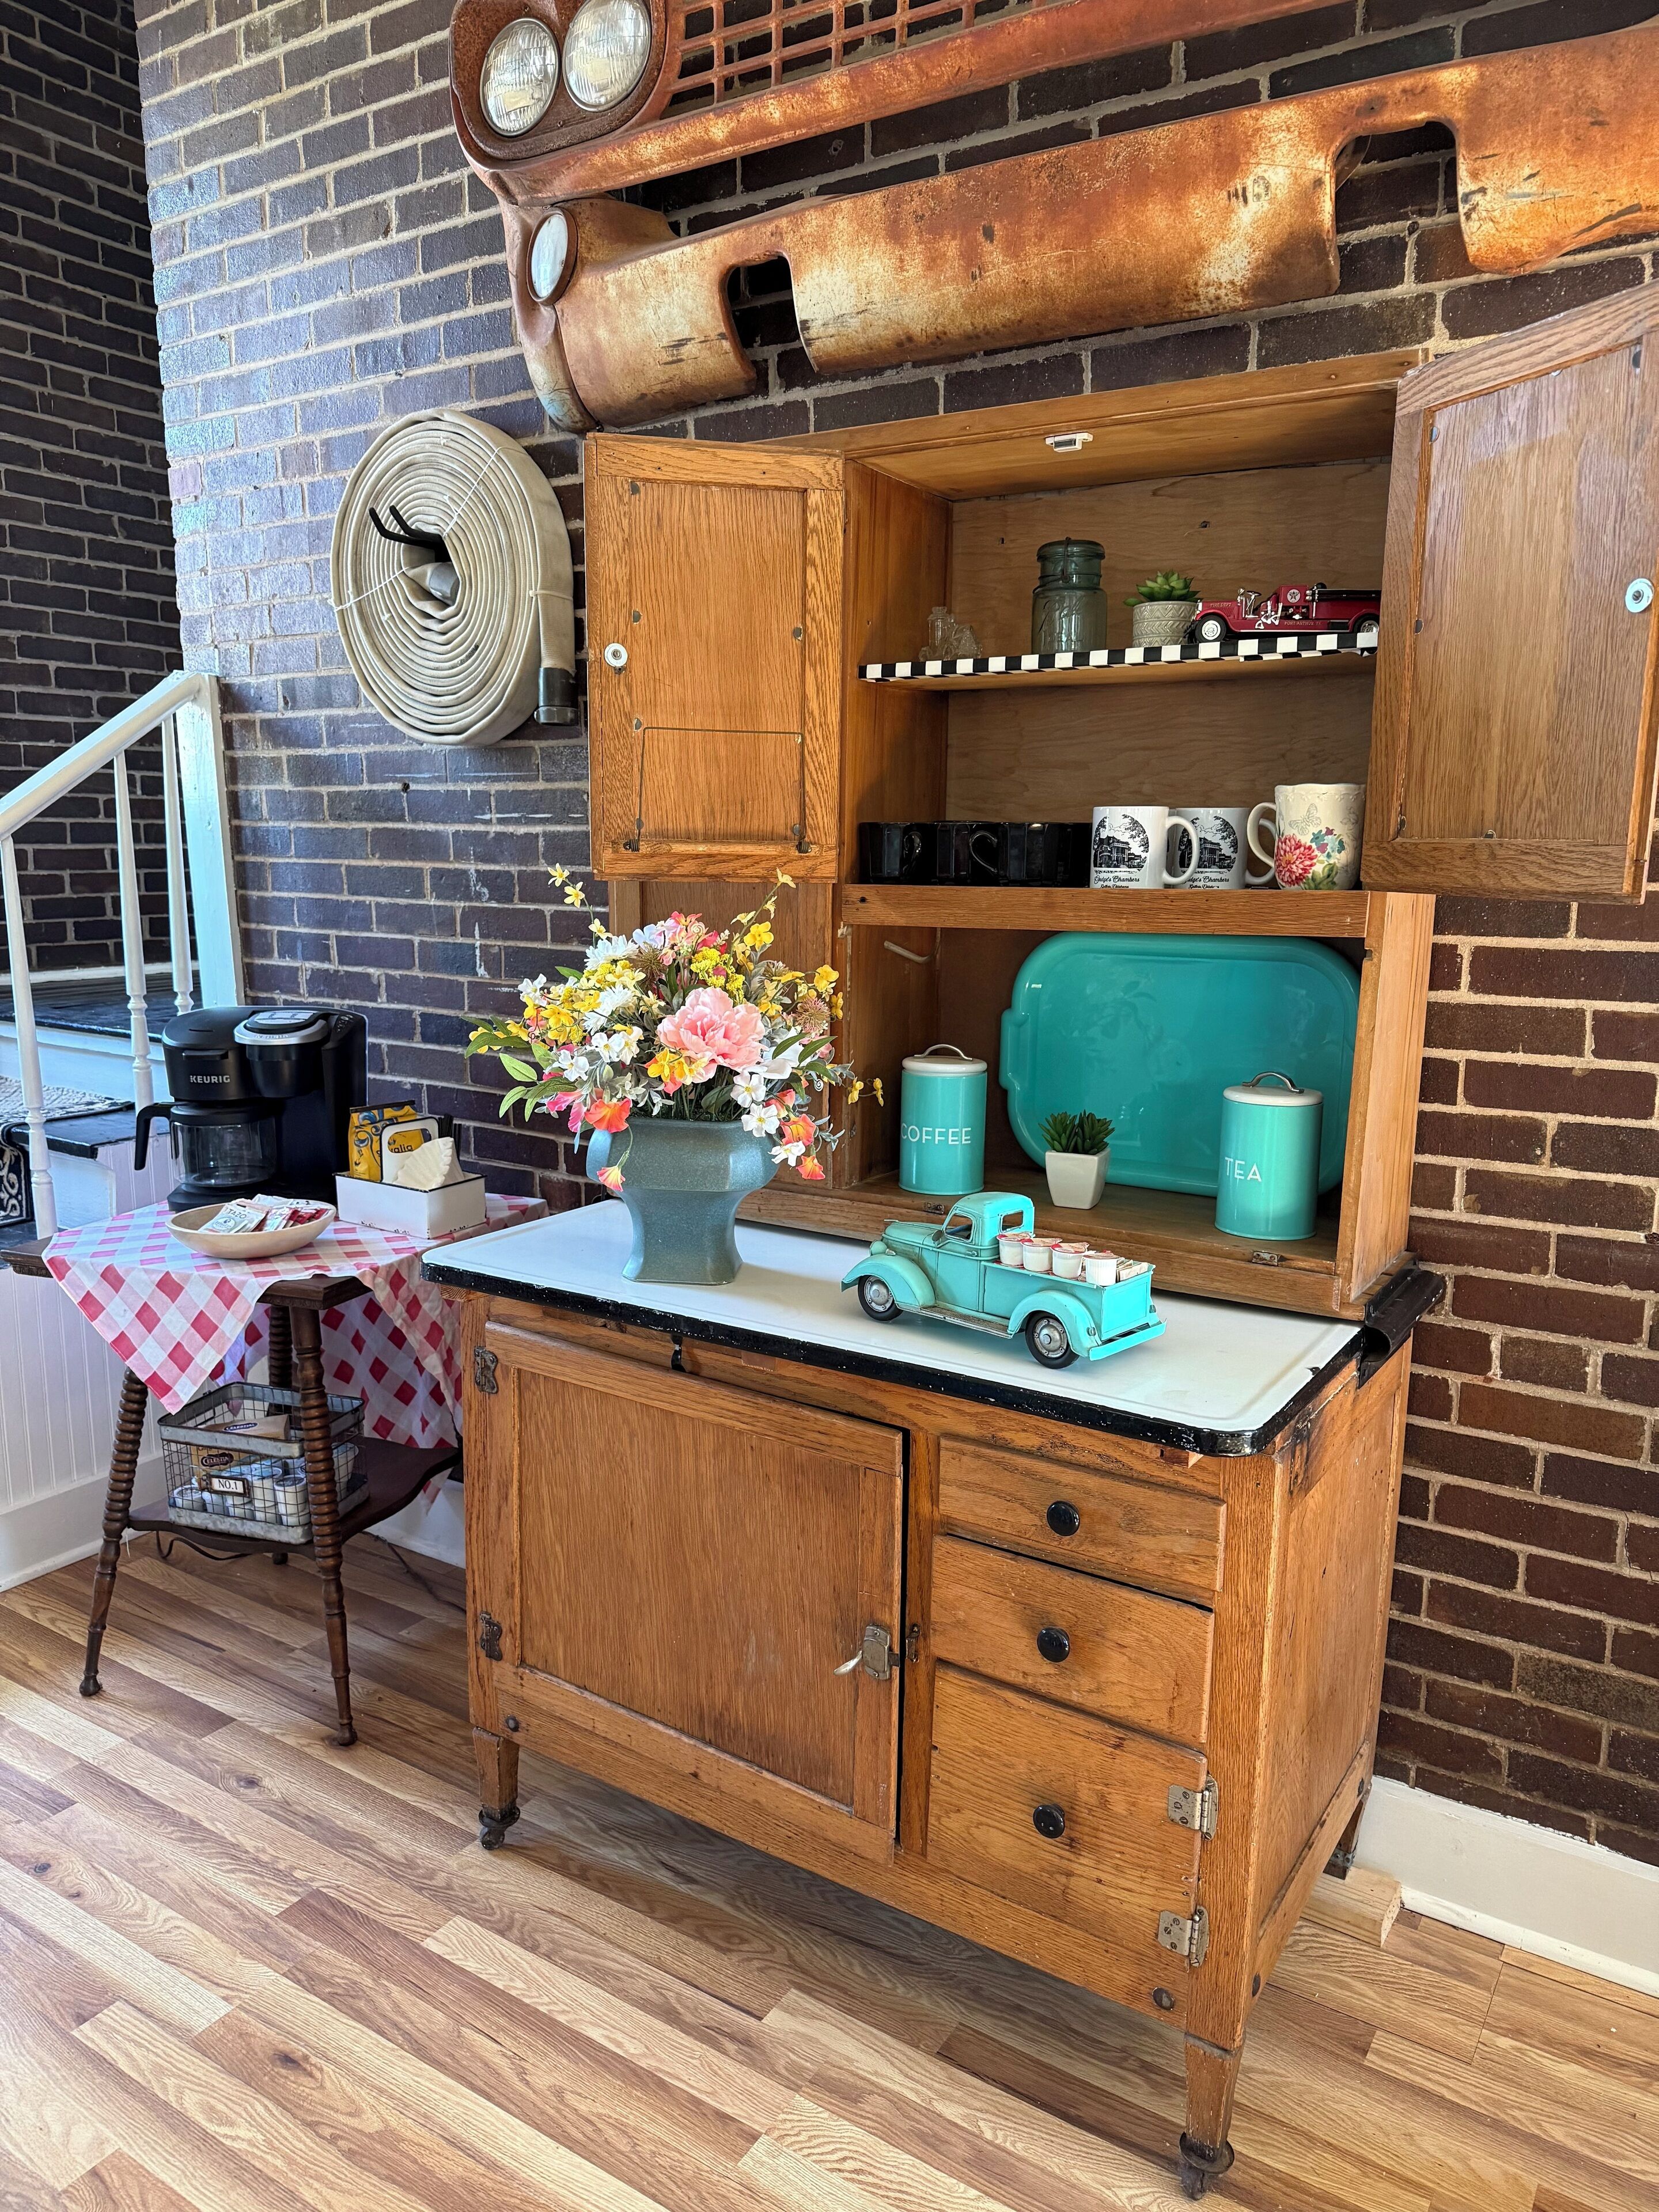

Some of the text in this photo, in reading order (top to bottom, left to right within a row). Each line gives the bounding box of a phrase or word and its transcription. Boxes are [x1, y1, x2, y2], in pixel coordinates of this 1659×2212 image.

[190, 1075, 230, 1084] KEURIG
[901, 1123, 972, 1145] COFFEE
[1225, 1157, 1262, 1183] TEA
[228, 1209, 247, 1219] TAZO
[218, 1479, 238, 1490] NO.1
